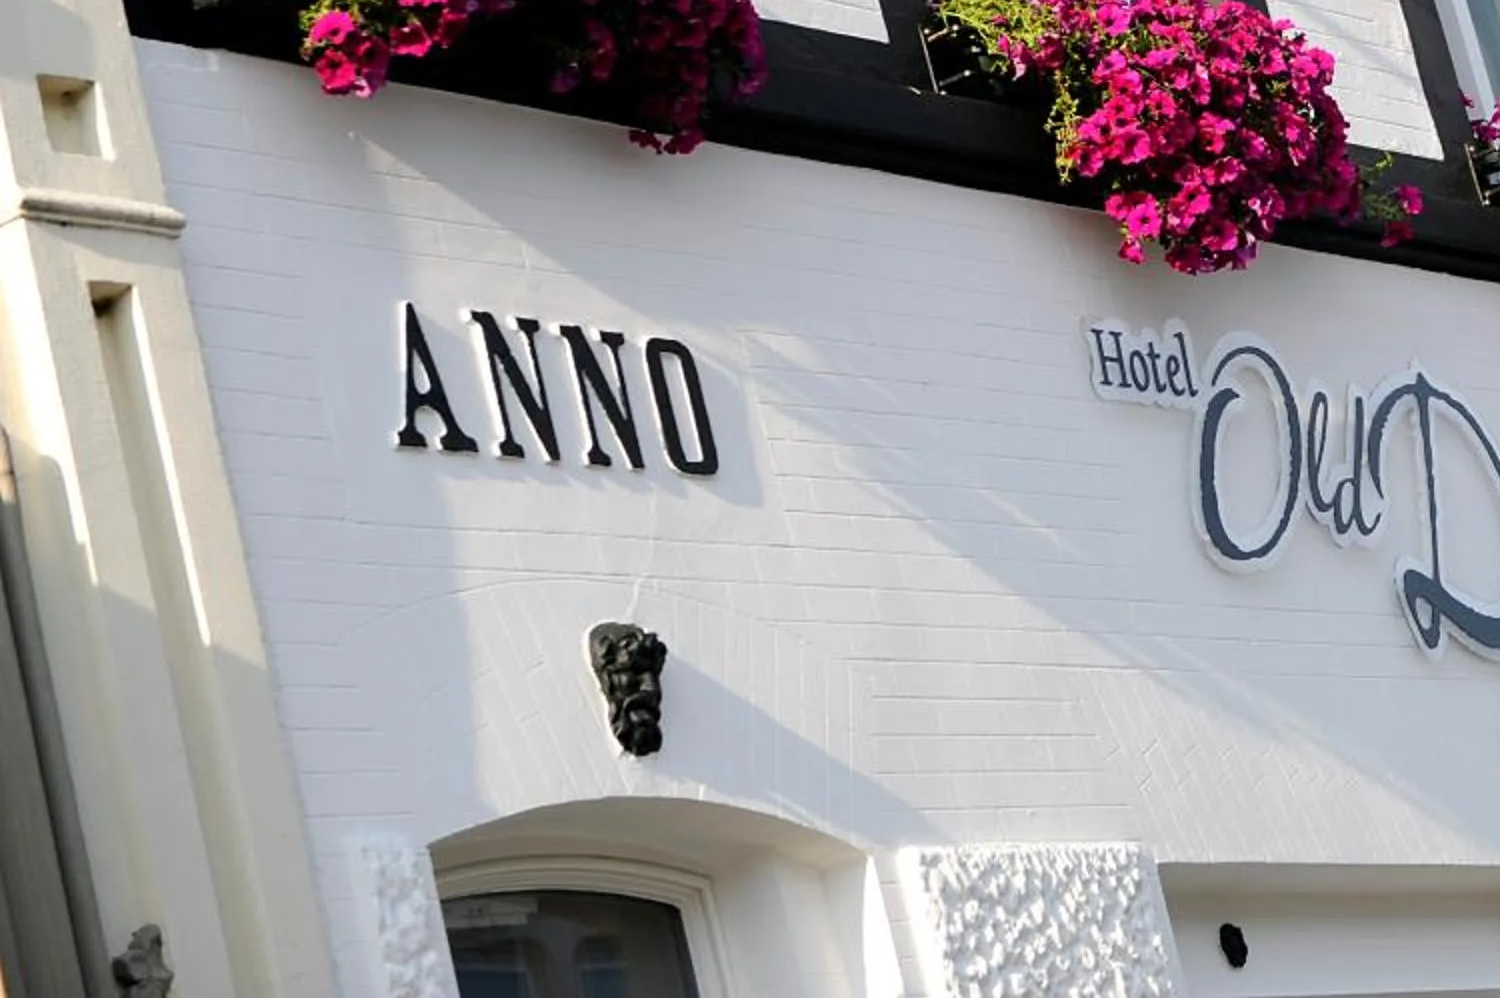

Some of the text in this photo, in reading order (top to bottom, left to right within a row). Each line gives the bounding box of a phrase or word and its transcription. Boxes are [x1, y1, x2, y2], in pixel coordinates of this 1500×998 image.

[397, 302, 718, 475] ANNO
[1090, 328, 1198, 397] Hotel
[1200, 346, 1382, 560] Old
